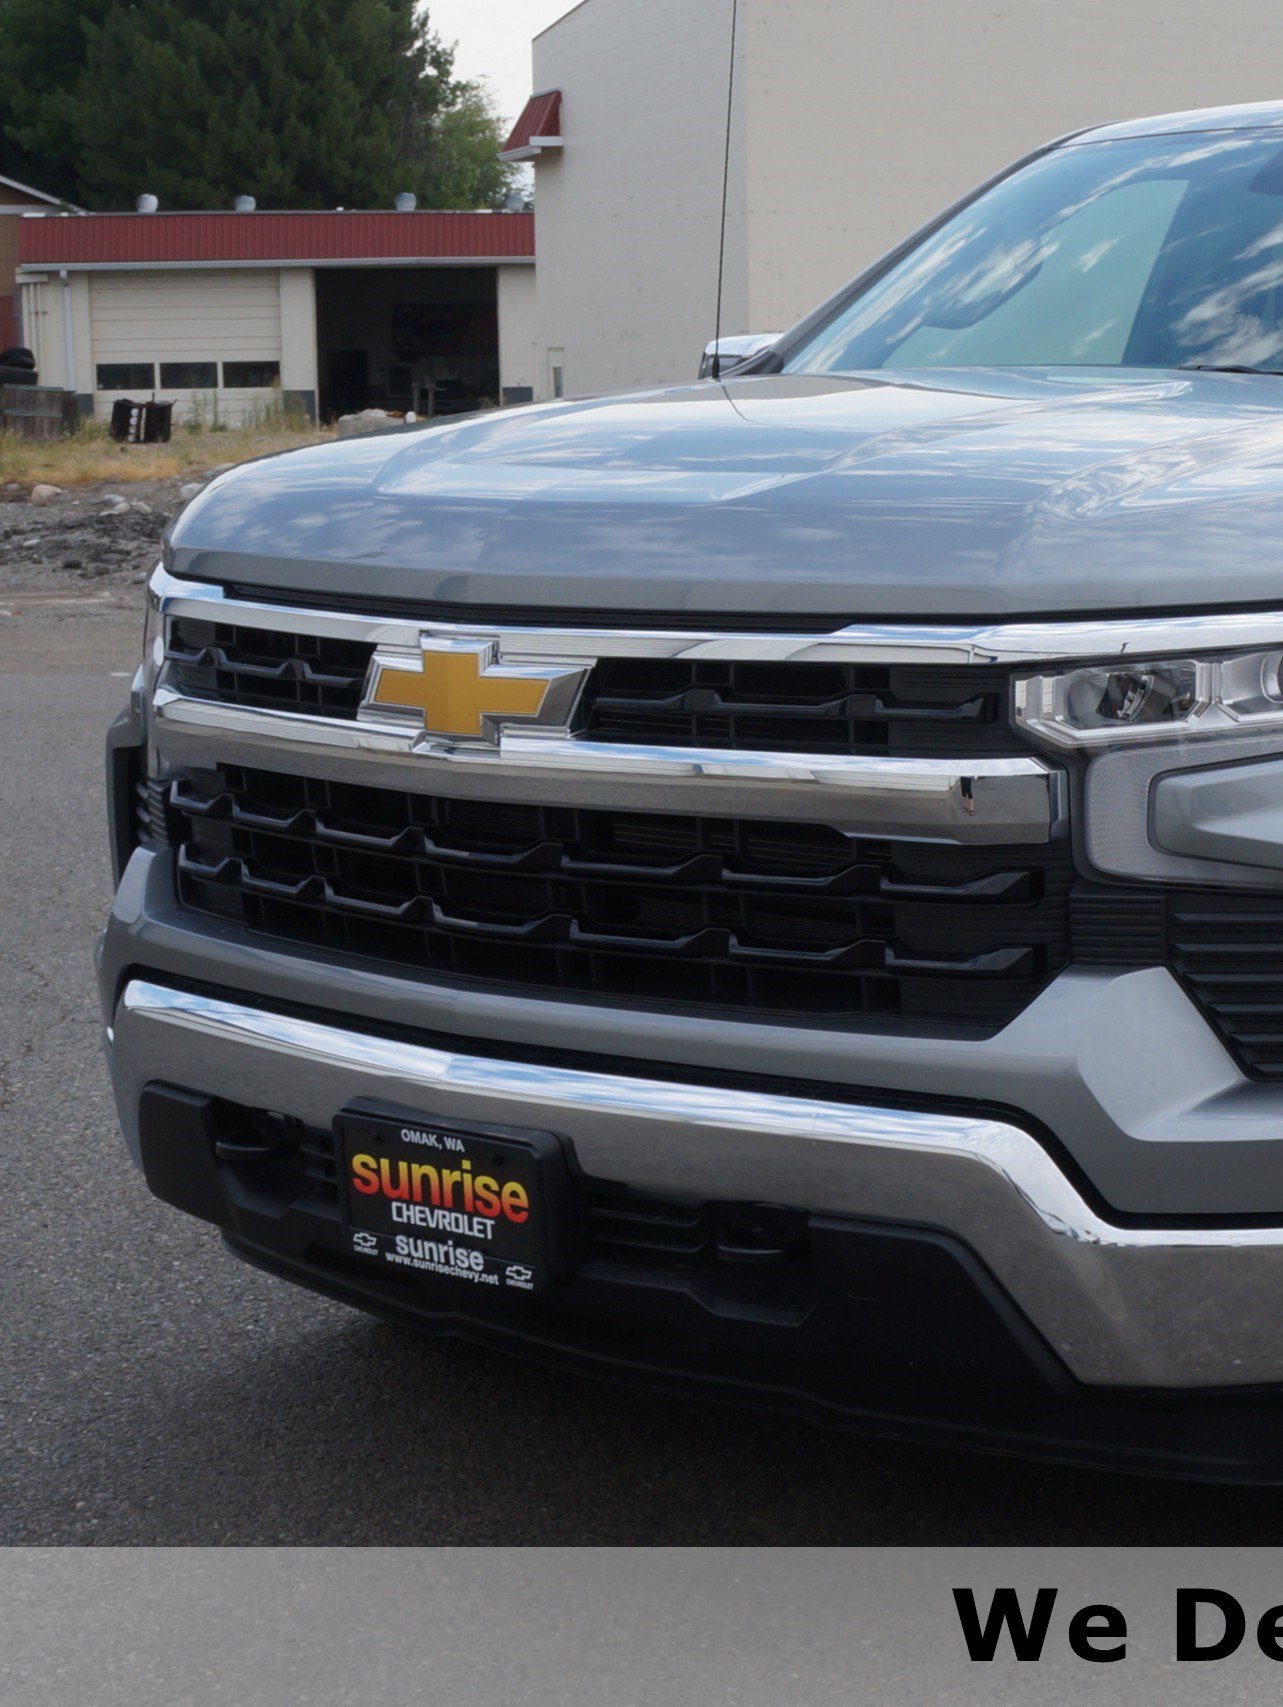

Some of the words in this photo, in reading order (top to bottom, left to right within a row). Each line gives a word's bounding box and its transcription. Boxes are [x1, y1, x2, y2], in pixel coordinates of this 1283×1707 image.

[401, 1128, 442, 1150] OMAK,
[444, 1136, 465, 1152] WA
[392, 1202, 495, 1240] CHEVROLET
[385, 1252, 499, 1286] www.sunrisechevy.net
[395, 1235, 484, 1271] sunrise
